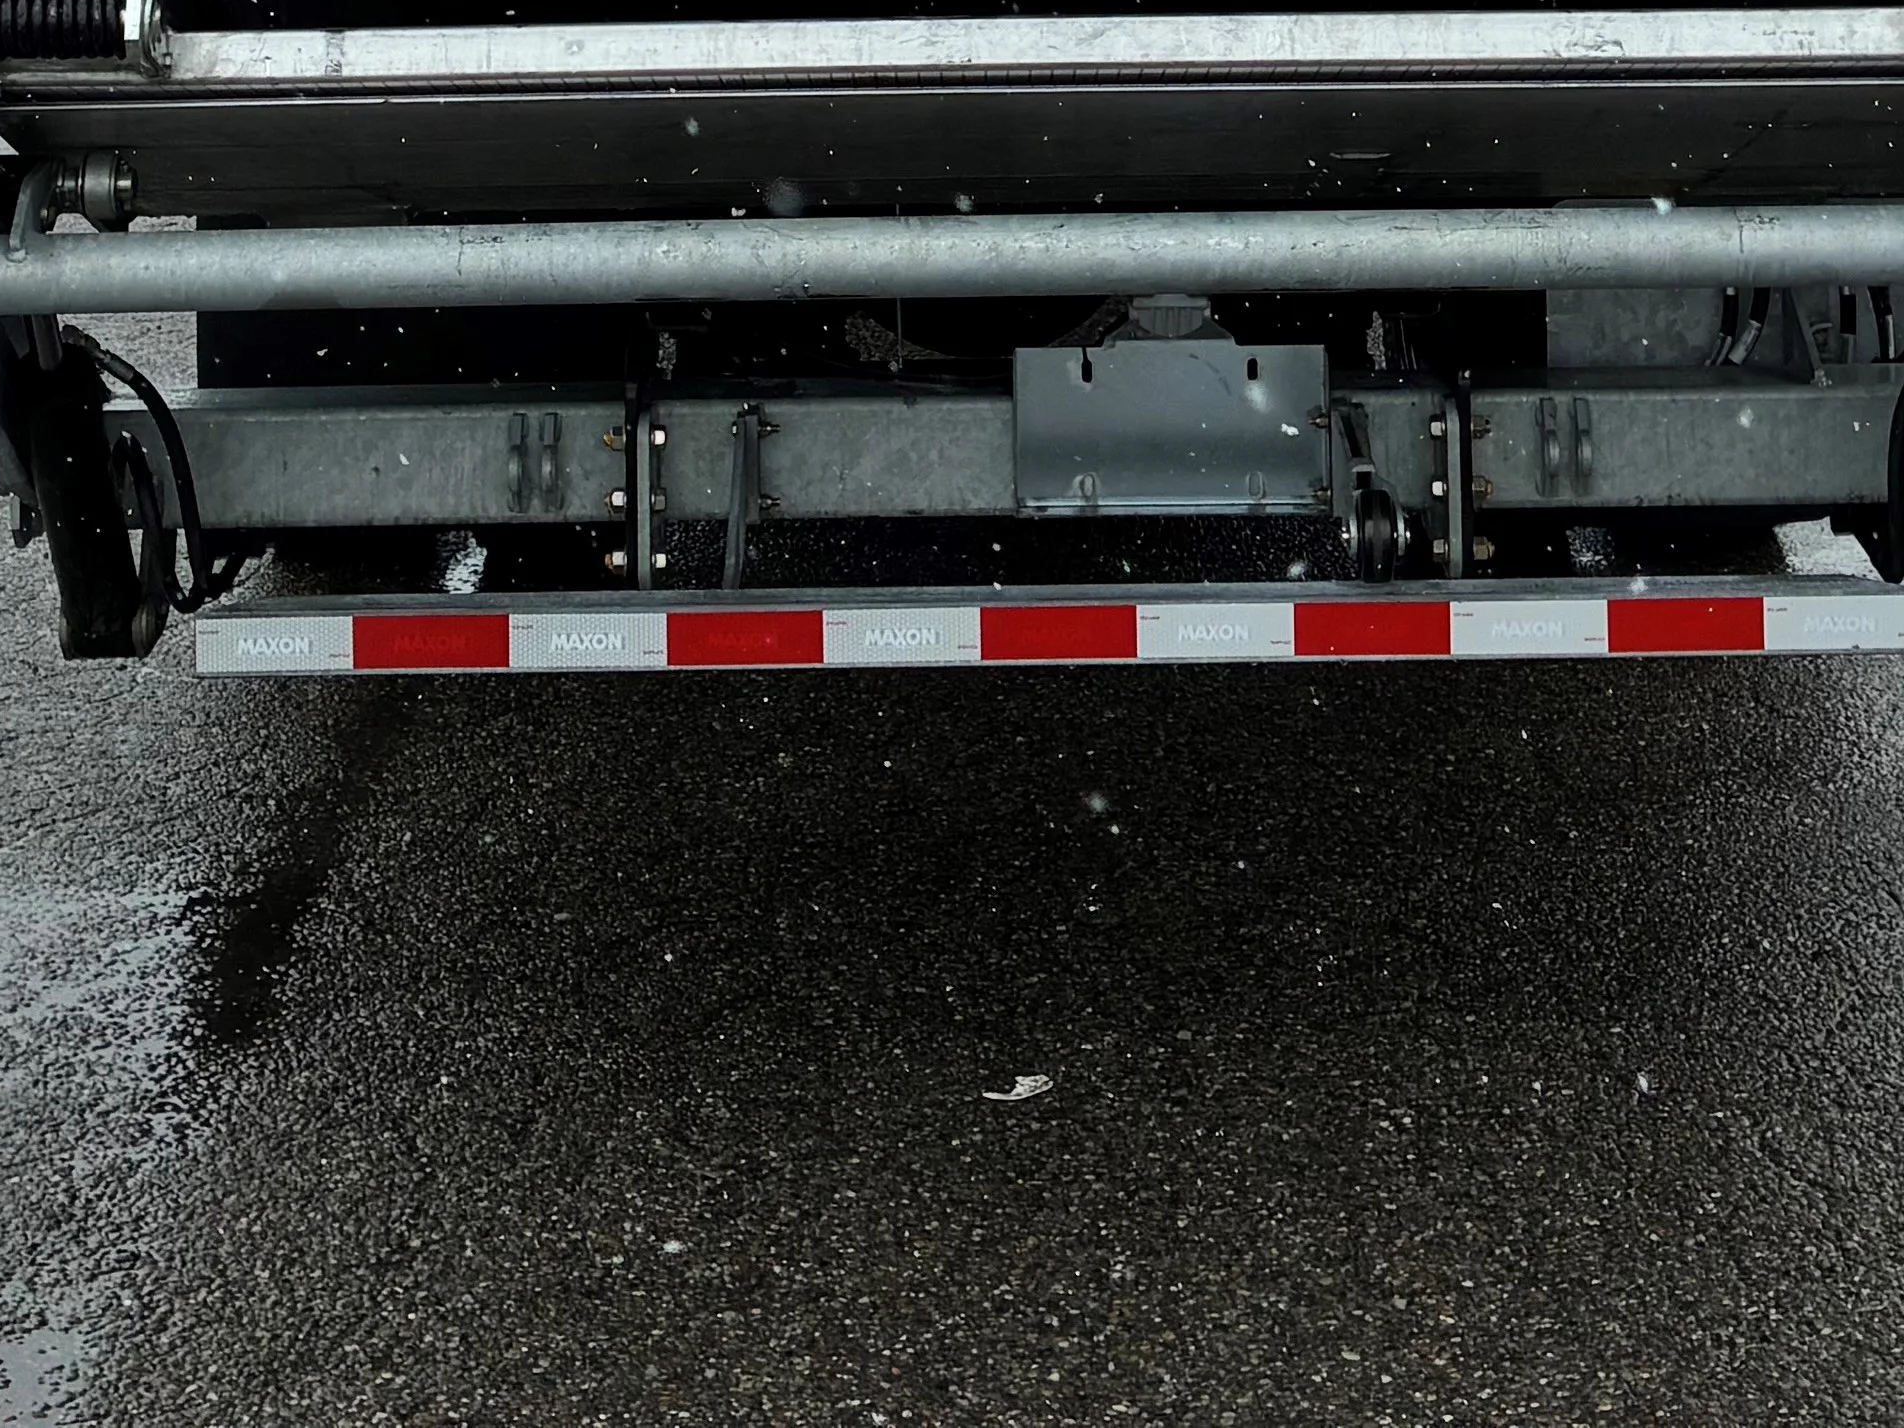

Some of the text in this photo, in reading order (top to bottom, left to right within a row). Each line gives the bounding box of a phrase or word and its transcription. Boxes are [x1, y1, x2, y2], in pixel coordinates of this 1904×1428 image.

[1178, 624, 1249, 642] MAXON
[1491, 620, 1564, 638] MAXON
[1804, 615, 1876, 633] MAXON
[551, 632, 624, 650] MAXON
[865, 628, 939, 646] MAXON
[238, 637, 310, 656] MAXON
